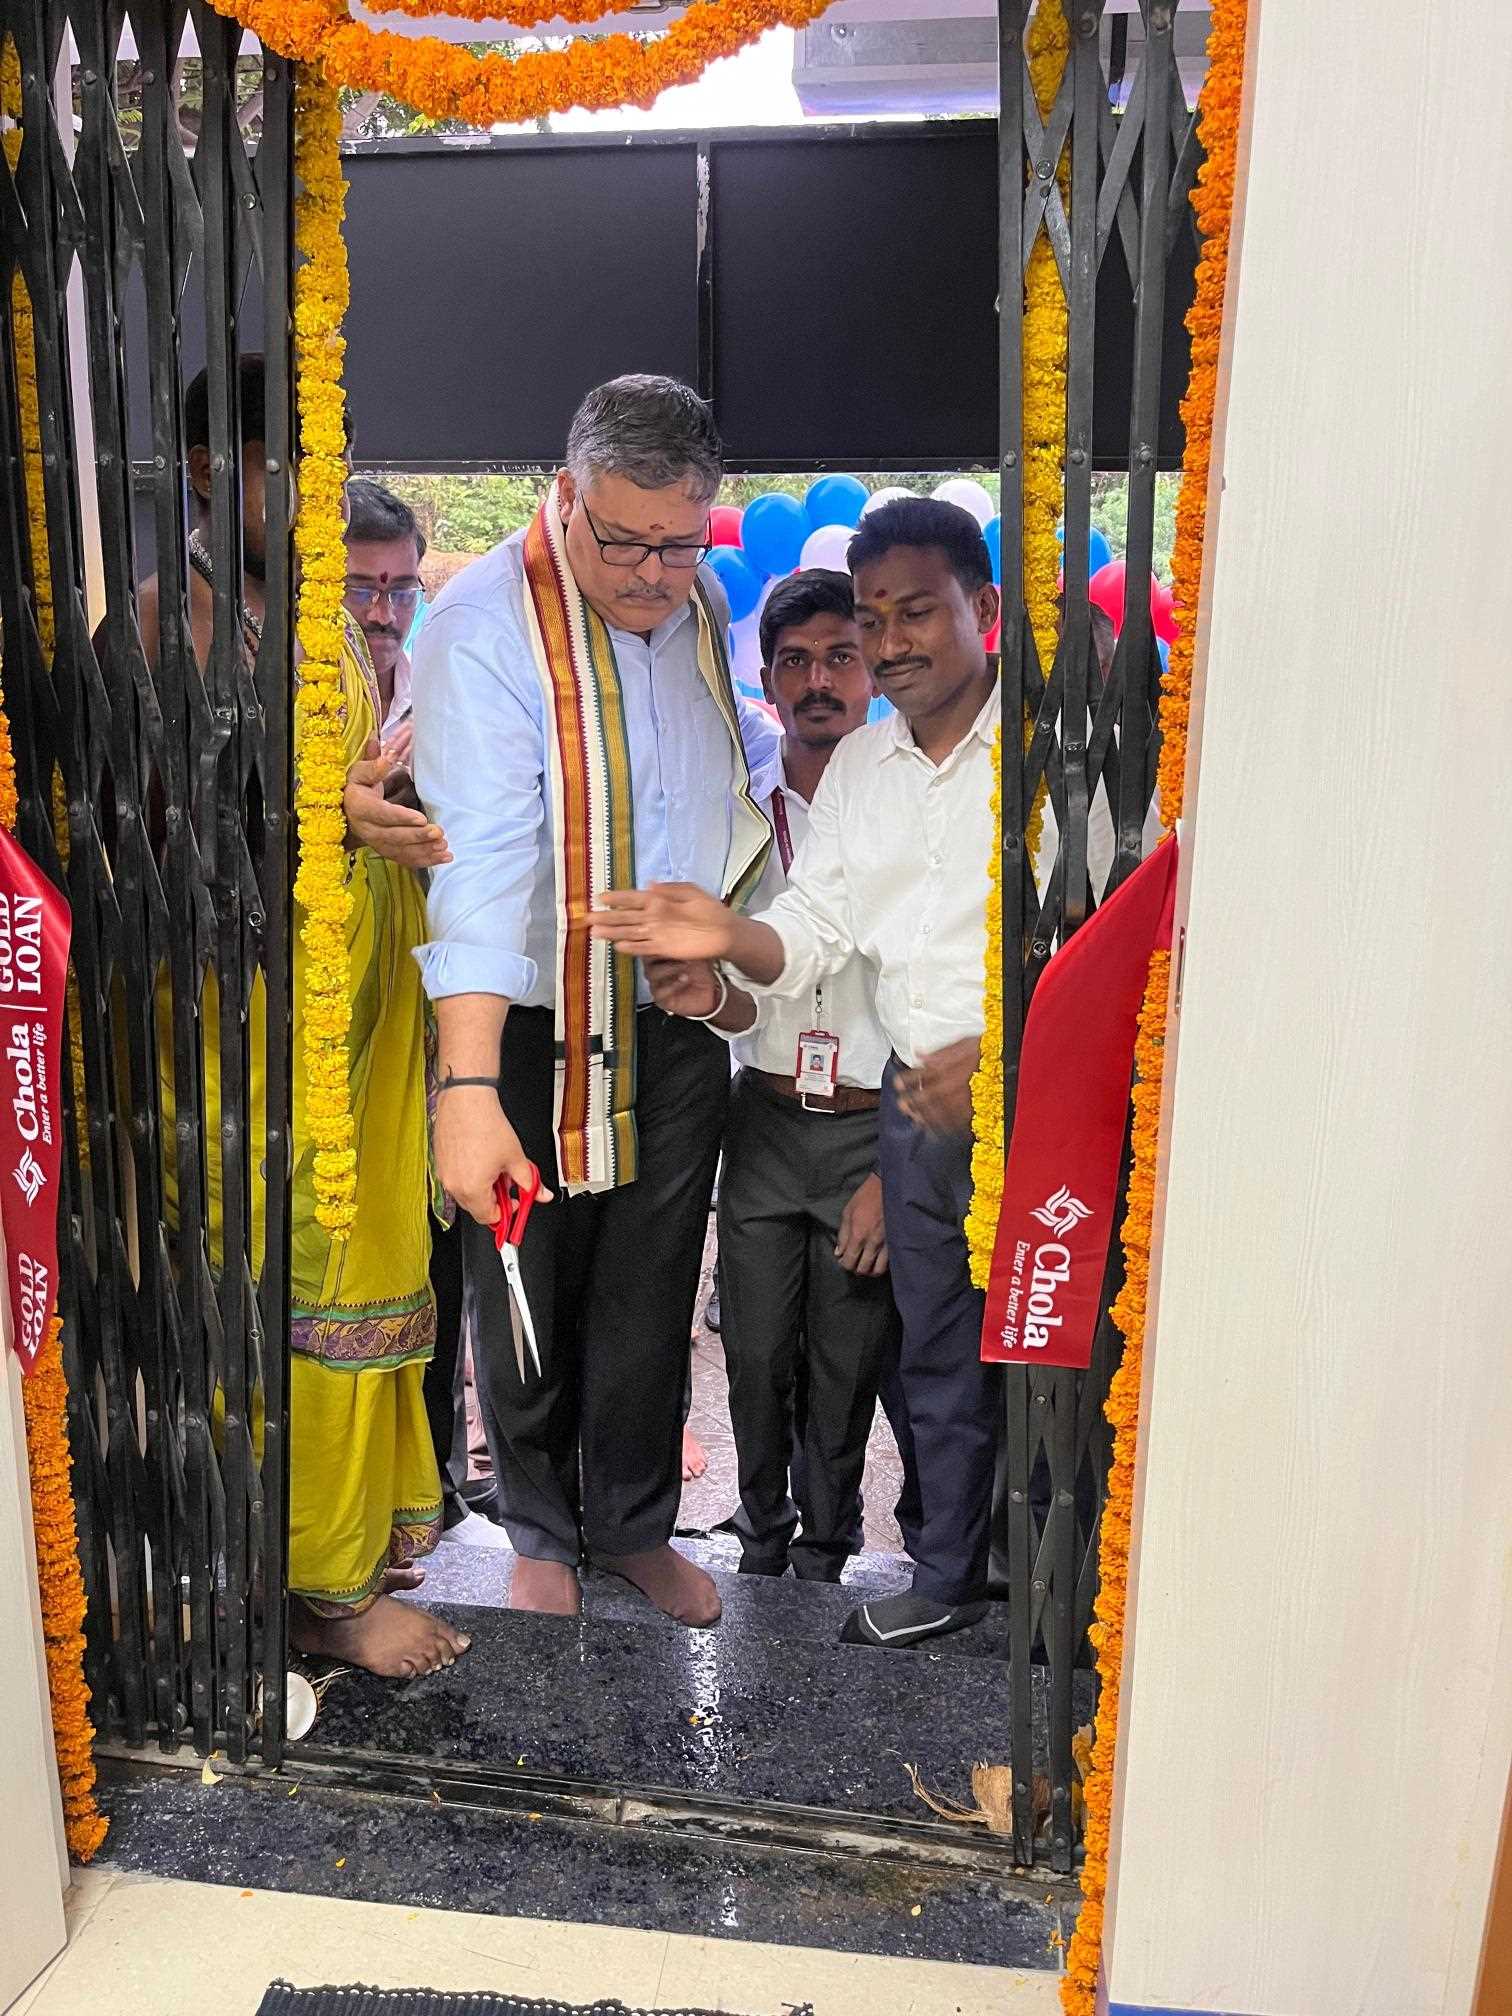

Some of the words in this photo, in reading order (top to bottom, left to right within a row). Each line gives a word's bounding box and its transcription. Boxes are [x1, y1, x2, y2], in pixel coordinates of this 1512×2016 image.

[14, 893, 43, 994] LOAN
[32, 1022, 48, 1047] life
[6, 1022, 39, 1141] Chola
[36, 1048, 47, 1091] better
[40, 1093, 49, 1104] a
[41, 1105, 52, 1145] Enter
[1013, 1240, 1031, 1275] Enter
[19, 1252, 34, 1347] GOLD
[1011, 1276, 1021, 1286] a
[1023, 1243, 1071, 1349] Chola
[28, 1259, 48, 1359] LOAN
[1006, 1287, 1024, 1324] better
[1000, 1325, 1019, 1349] life
